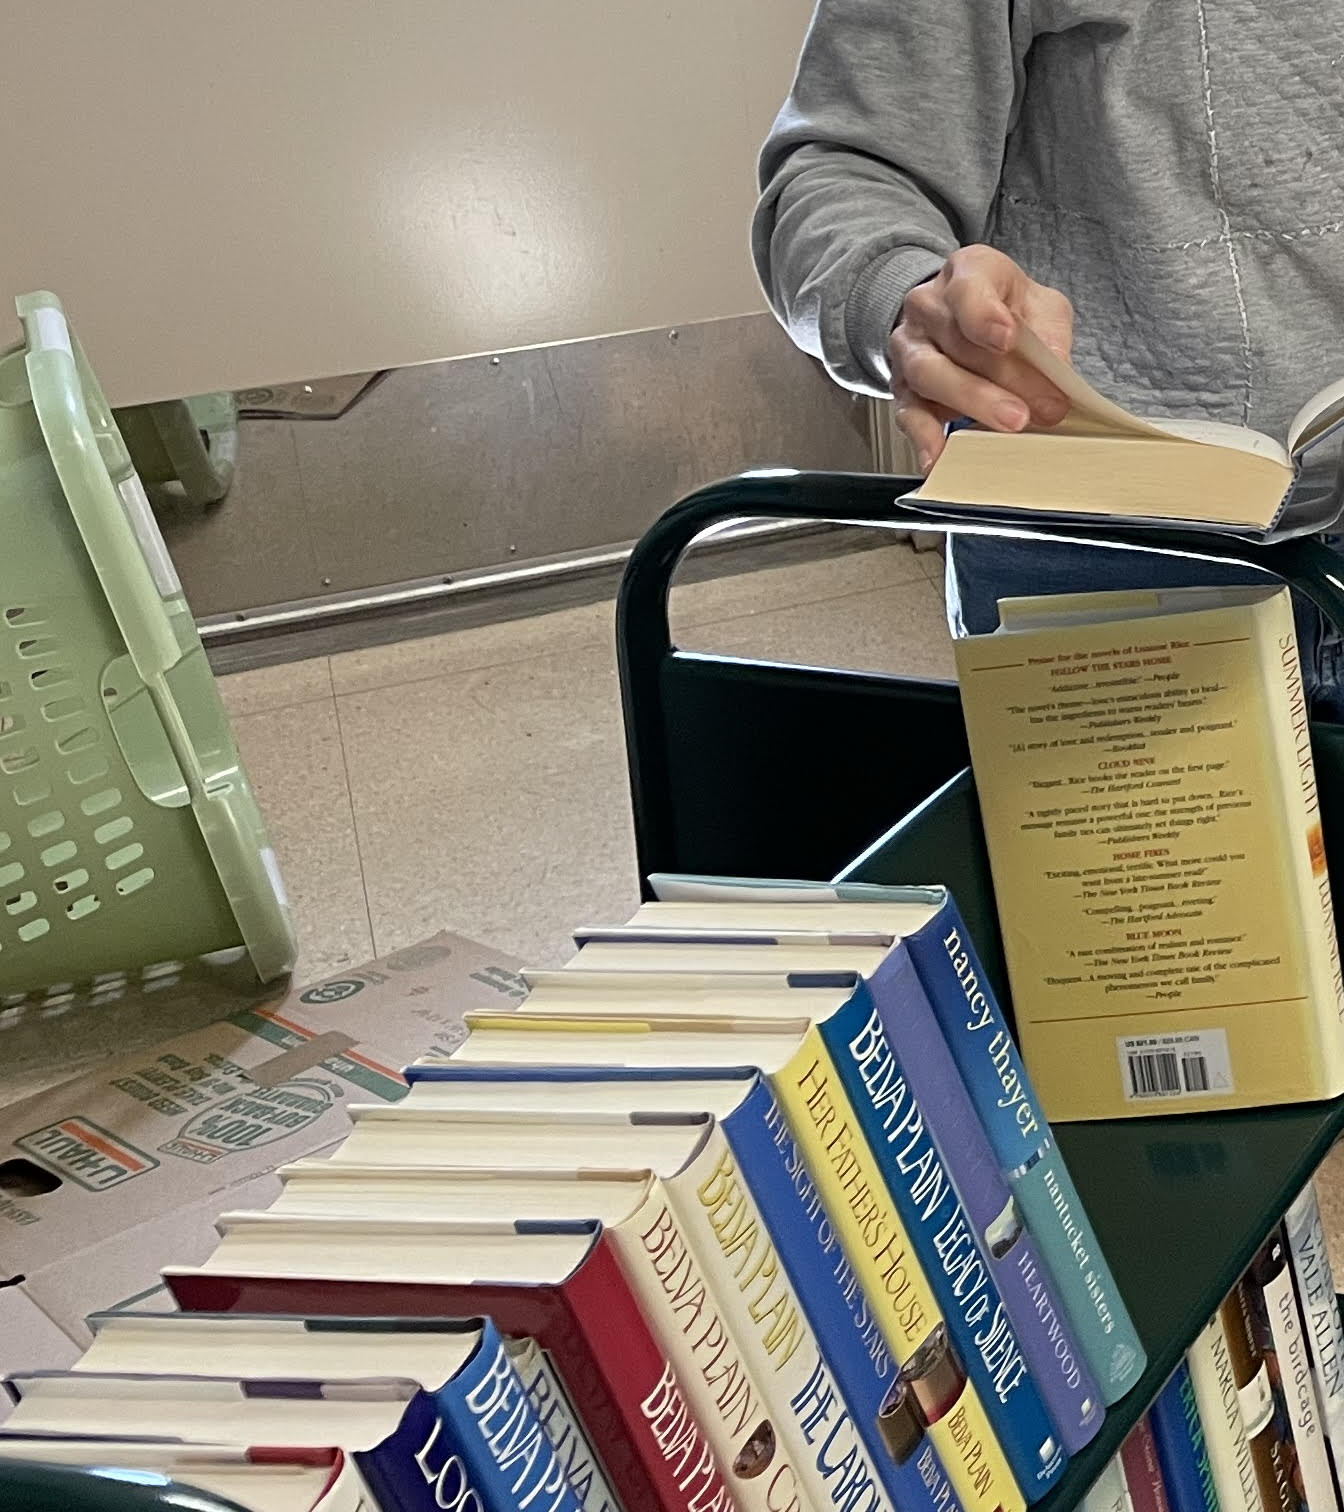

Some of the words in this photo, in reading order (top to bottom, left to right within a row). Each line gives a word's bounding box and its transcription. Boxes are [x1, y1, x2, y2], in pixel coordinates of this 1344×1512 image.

[1278, 633, 1306, 736] SUMMER
[1296, 737, 1317, 816] LIGHT
[848, 1008, 907, 1130] BELVA
[943, 927, 995, 1032] nancy
[985, 1029, 1039, 1138] thayer
[33, 1129, 128, 1185] U-HAUL
[188, 1114, 273, 1147] 100%
[887, 1099, 951, 1222] PLAIN
[696, 1148, 758, 1279] BELVA
[739, 1247, 806, 1373] PLAIN
[763, 1097, 787, 1154] THE
[783, 1138, 823, 1222] SIGHT
[832, 1254, 858, 1311] THE
[853, 1305, 890, 1379] STARS
[797, 1059, 837, 1139] HER
[827, 1122, 889, 1249] FATHER'S
[873, 1233, 929, 1343] HOUSE
[933, 1200, 987, 1306] LEGACY
[1043, 1169, 1091, 1271] nantucket
[1085, 1271, 1116, 1335] sisters
[640, 1206, 707, 1335] BELVA
[691, 1314, 758, 1439] PLAIN
[963, 1293, 990, 1328] OF
[974, 1301, 1028, 1405] SILENCE
[1017, 1250, 1082, 1390] HEARTWOOD
[1279, 1291, 1294, 1334] the
[1288, 1335, 1315, 1438] birdcage
[1298, 1232, 1321, 1306] VALE
[1311, 1308, 1343, 1399] ALLEN
[465, 1342, 543, 1495] BELVA
[640, 1361, 698, 1478] BELVA
[789, 1346, 832, 1446] THE
[1210, 1333, 1237, 1430] MARCIA
[962, 1450, 995, 1499] PLAIN
